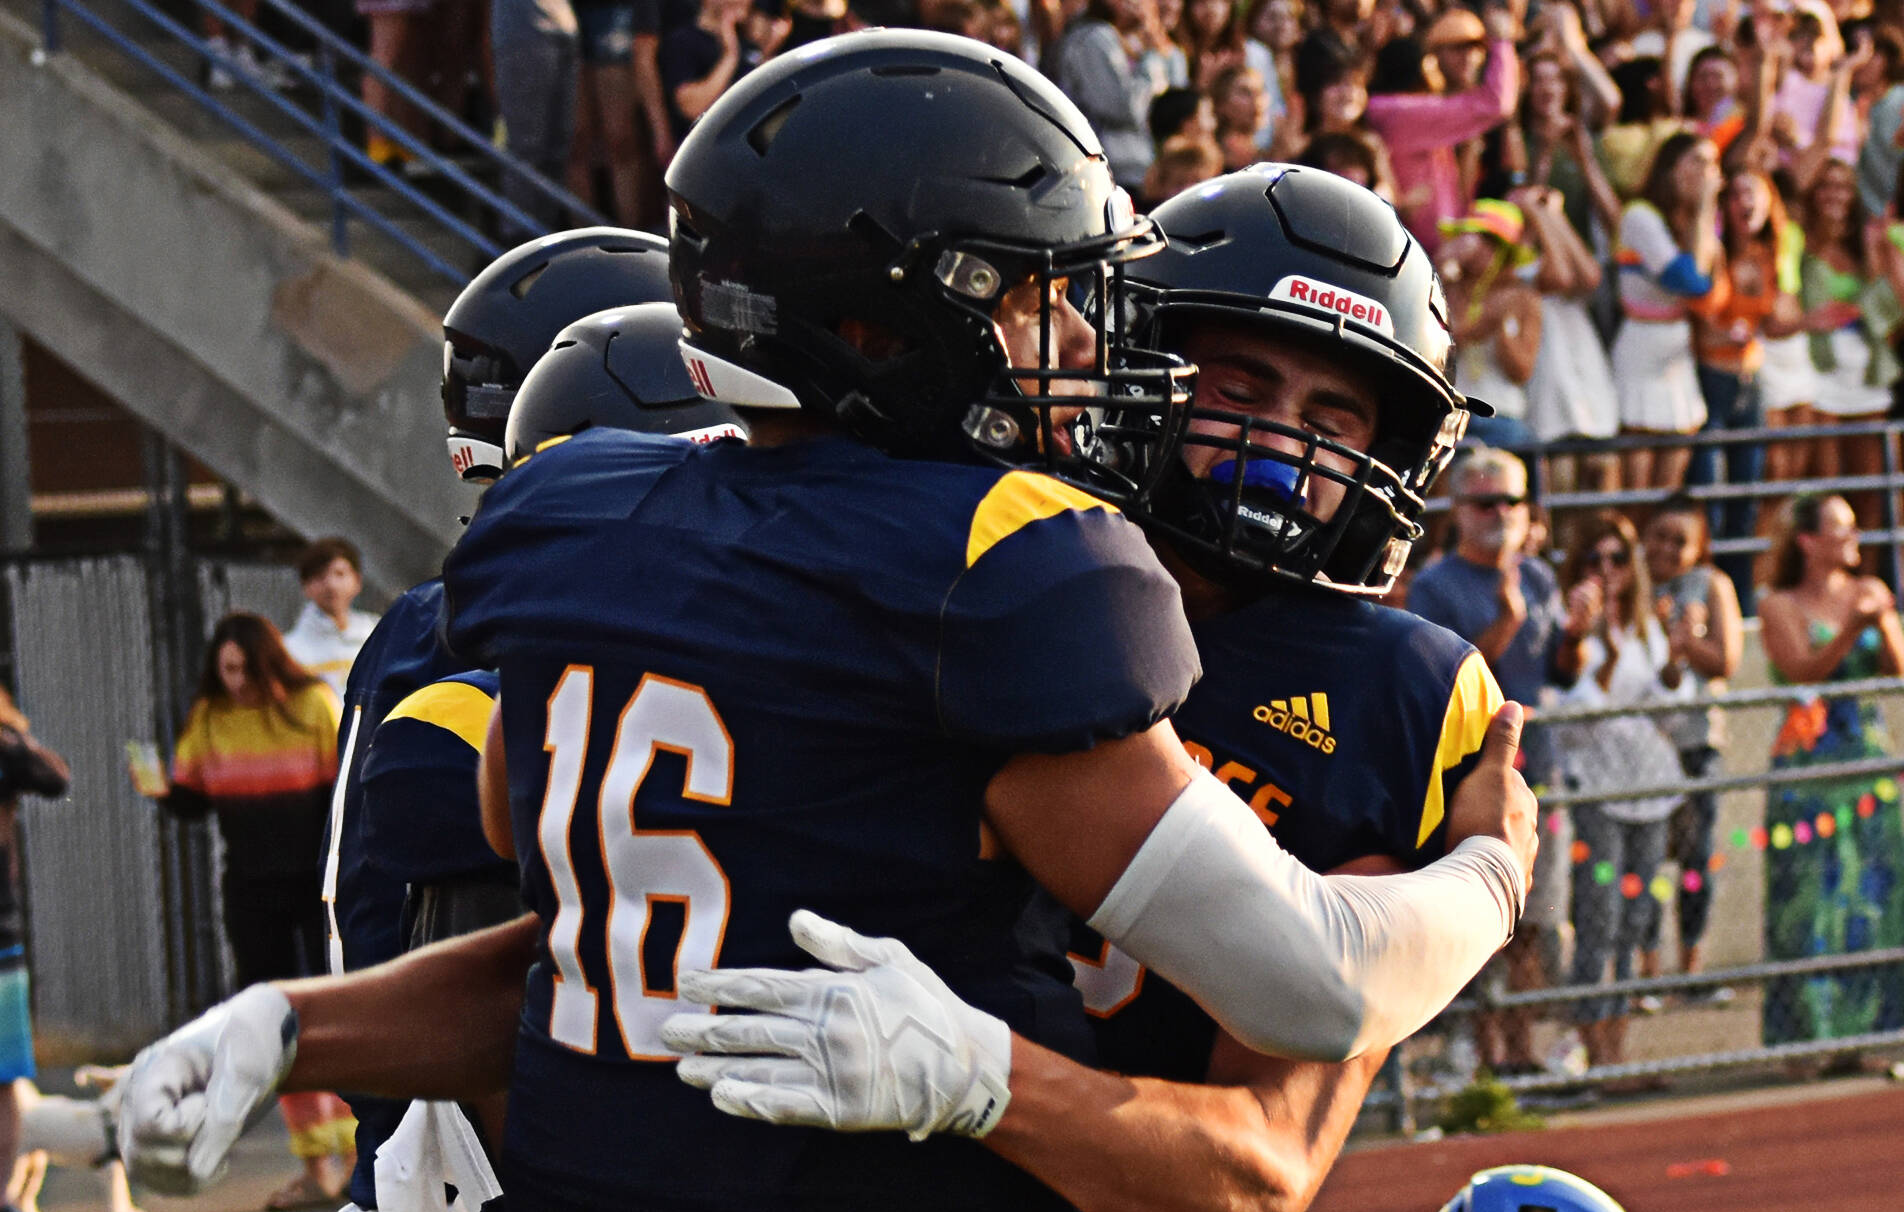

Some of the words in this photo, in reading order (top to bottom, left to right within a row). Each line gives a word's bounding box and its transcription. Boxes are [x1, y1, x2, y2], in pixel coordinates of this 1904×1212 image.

[1289, 279, 1382, 326] Riddell
[1237, 505, 1284, 531] Riddel
[1253, 704, 1337, 754] adidas
[538, 664, 734, 1062] 16
